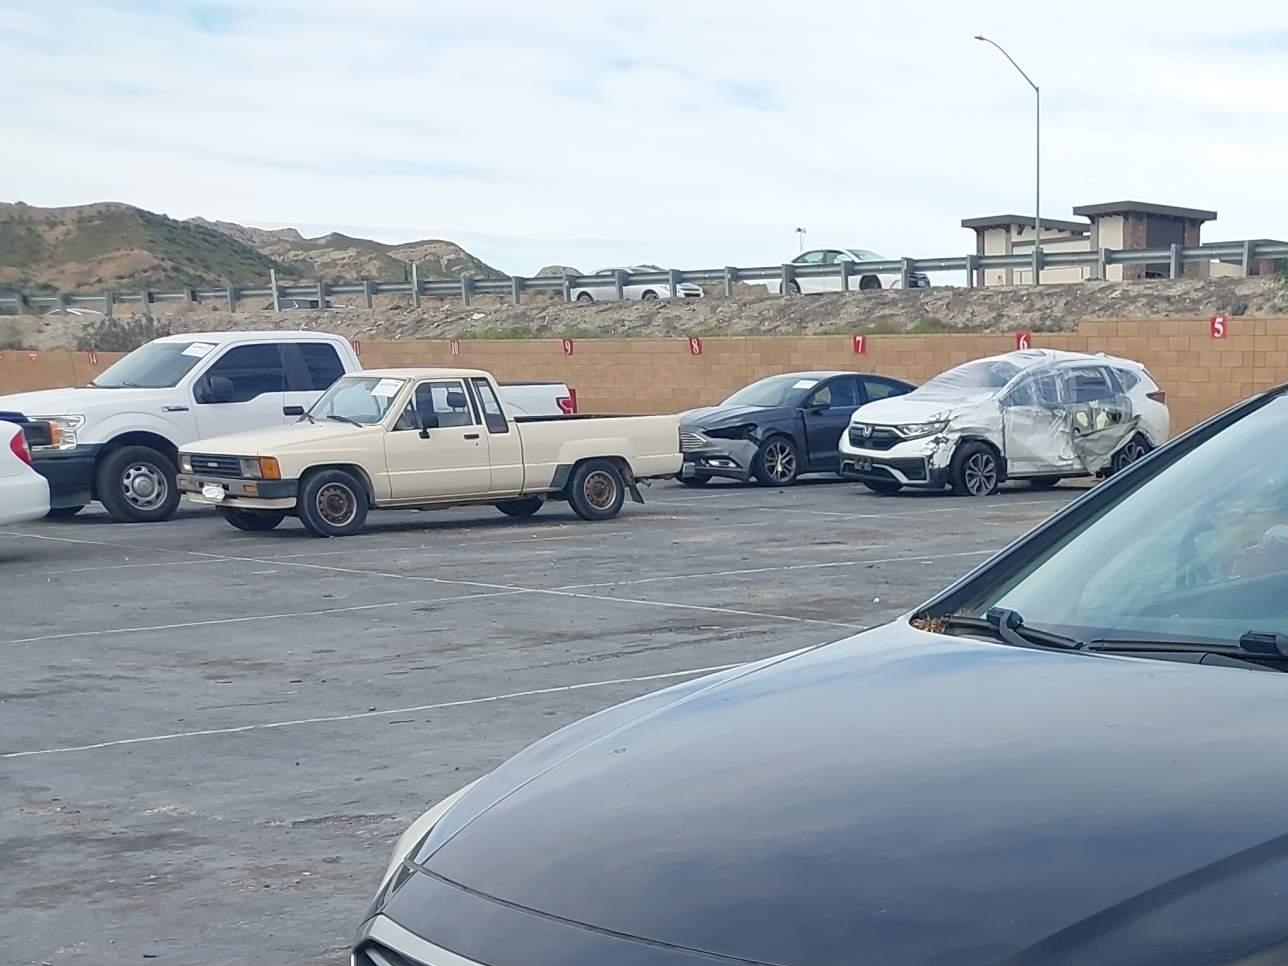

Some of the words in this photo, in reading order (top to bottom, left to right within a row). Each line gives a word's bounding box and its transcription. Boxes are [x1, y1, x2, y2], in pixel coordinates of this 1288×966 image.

[1213, 317, 1224, 337] 5
[450, 341, 459, 355] 10
[564, 340, 571, 355] 9
[691, 338, 700, 354] 8
[856, 336, 863, 352] 7
[1019, 334, 1028, 350] 6
